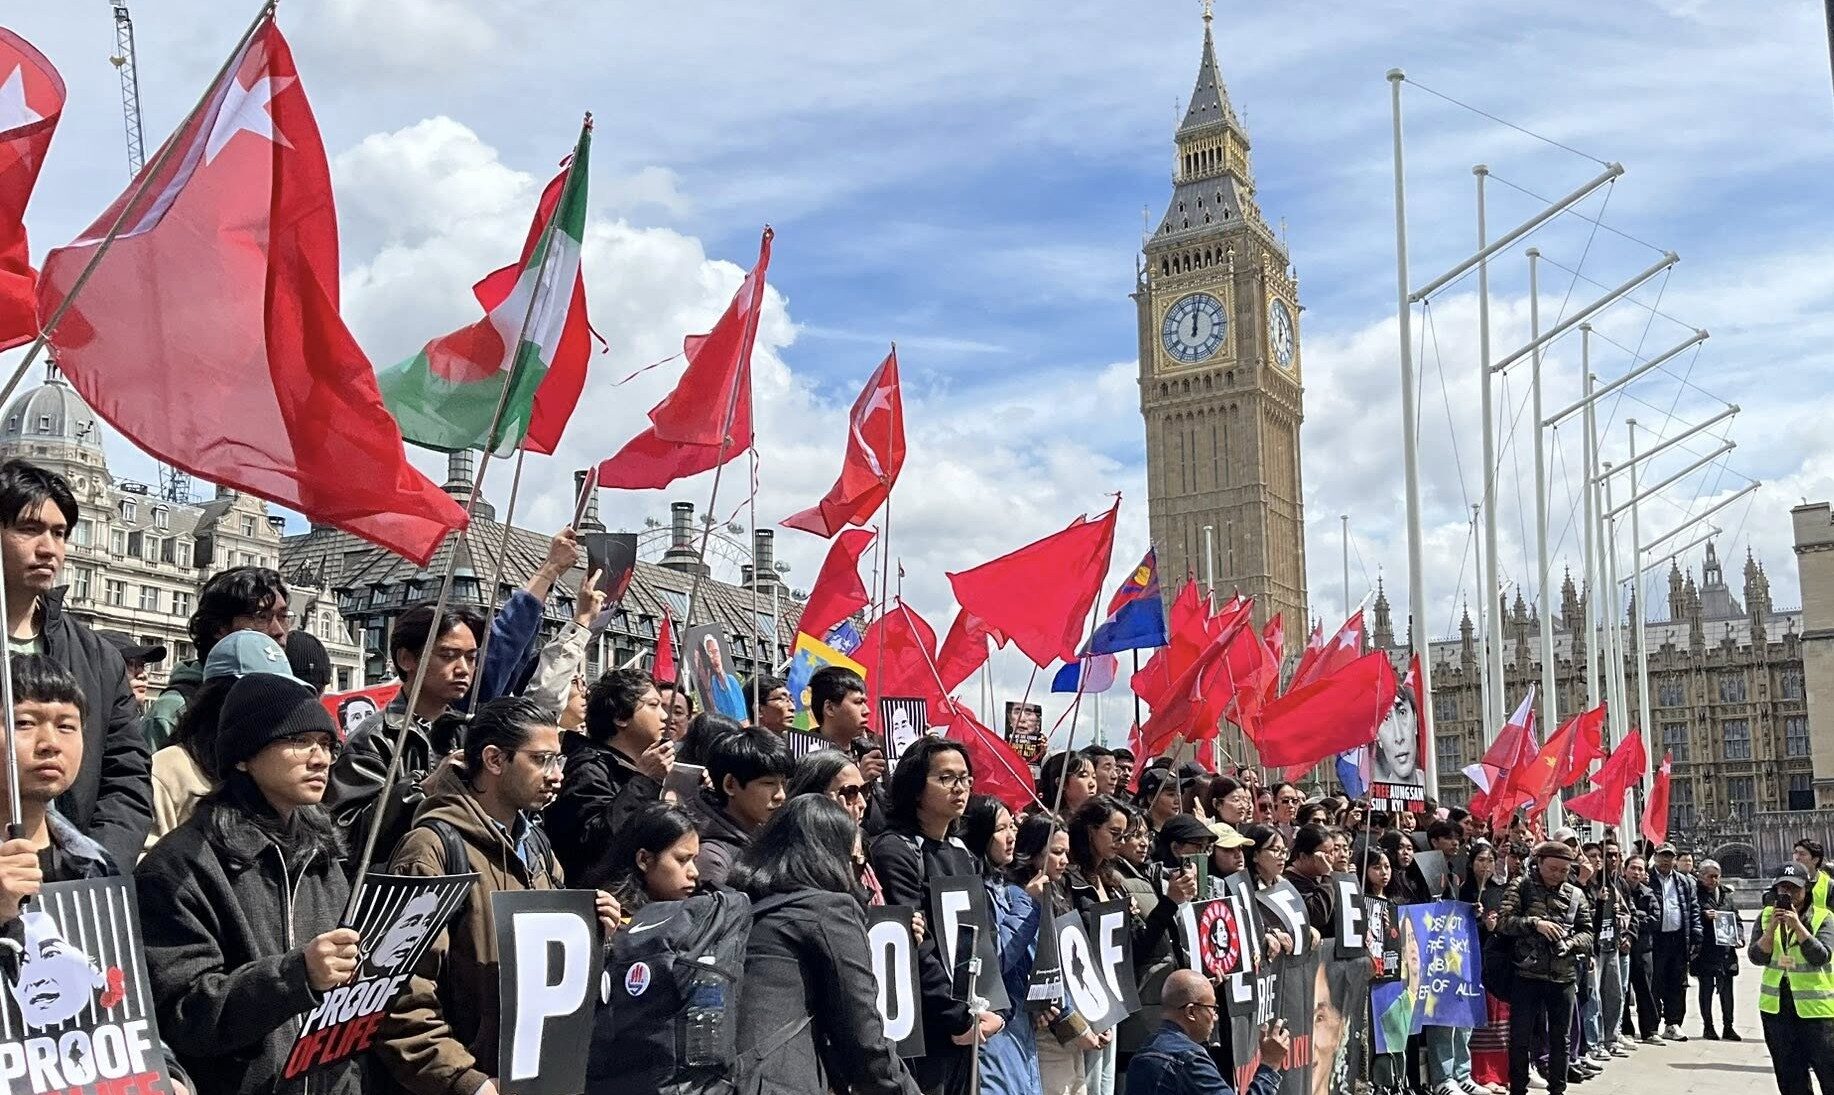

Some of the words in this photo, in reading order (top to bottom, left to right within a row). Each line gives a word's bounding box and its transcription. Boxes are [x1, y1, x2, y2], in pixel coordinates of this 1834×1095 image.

[1370, 798, 1387, 811] SUU
[300, 973, 409, 1039] PROOF
[1456, 983, 1480, 997] ALL
[0, 1019, 151, 1095] PROOF
[284, 1028, 329, 1079] OF
[318, 1011, 385, 1065] LIFE
